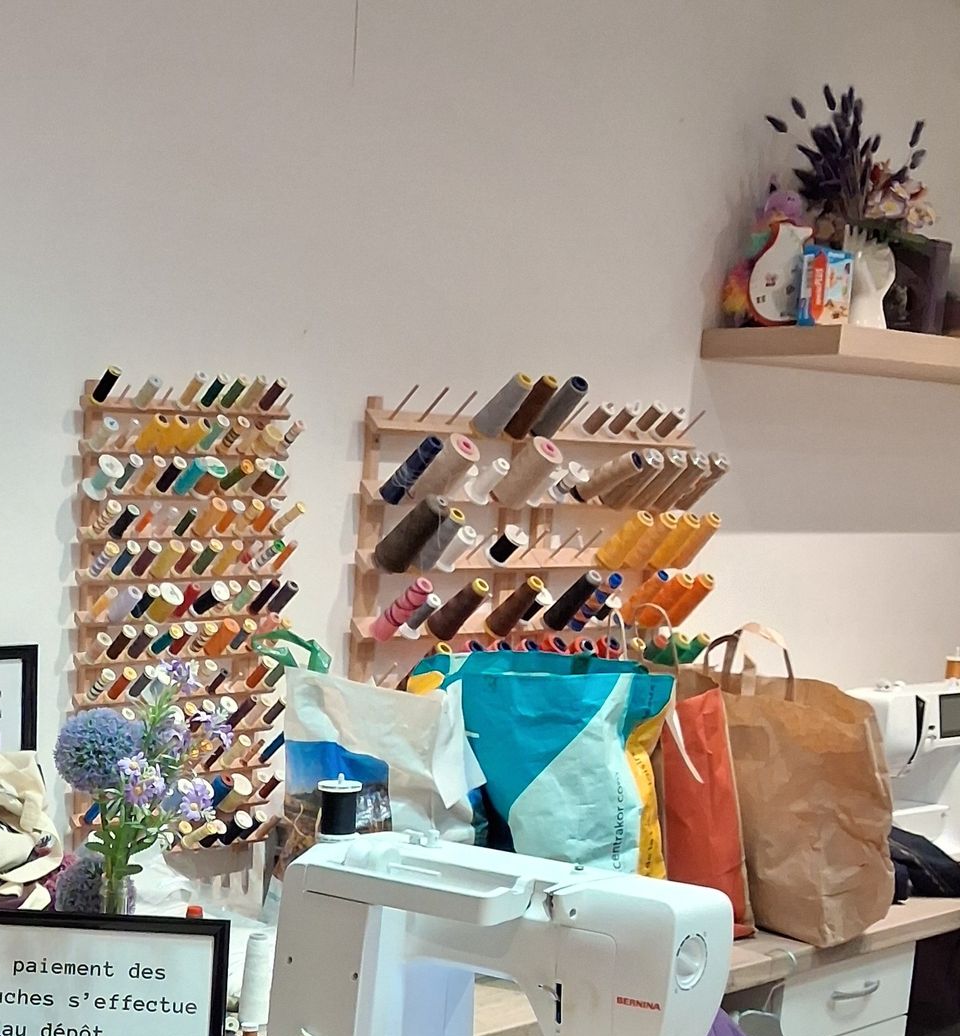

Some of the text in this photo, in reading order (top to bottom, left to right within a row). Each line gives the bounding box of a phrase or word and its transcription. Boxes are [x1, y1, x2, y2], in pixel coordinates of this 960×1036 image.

[13, 957, 115, 978] paiement
[128, 962, 167, 980] des
[616, 996, 661, 1011] BERNINA
